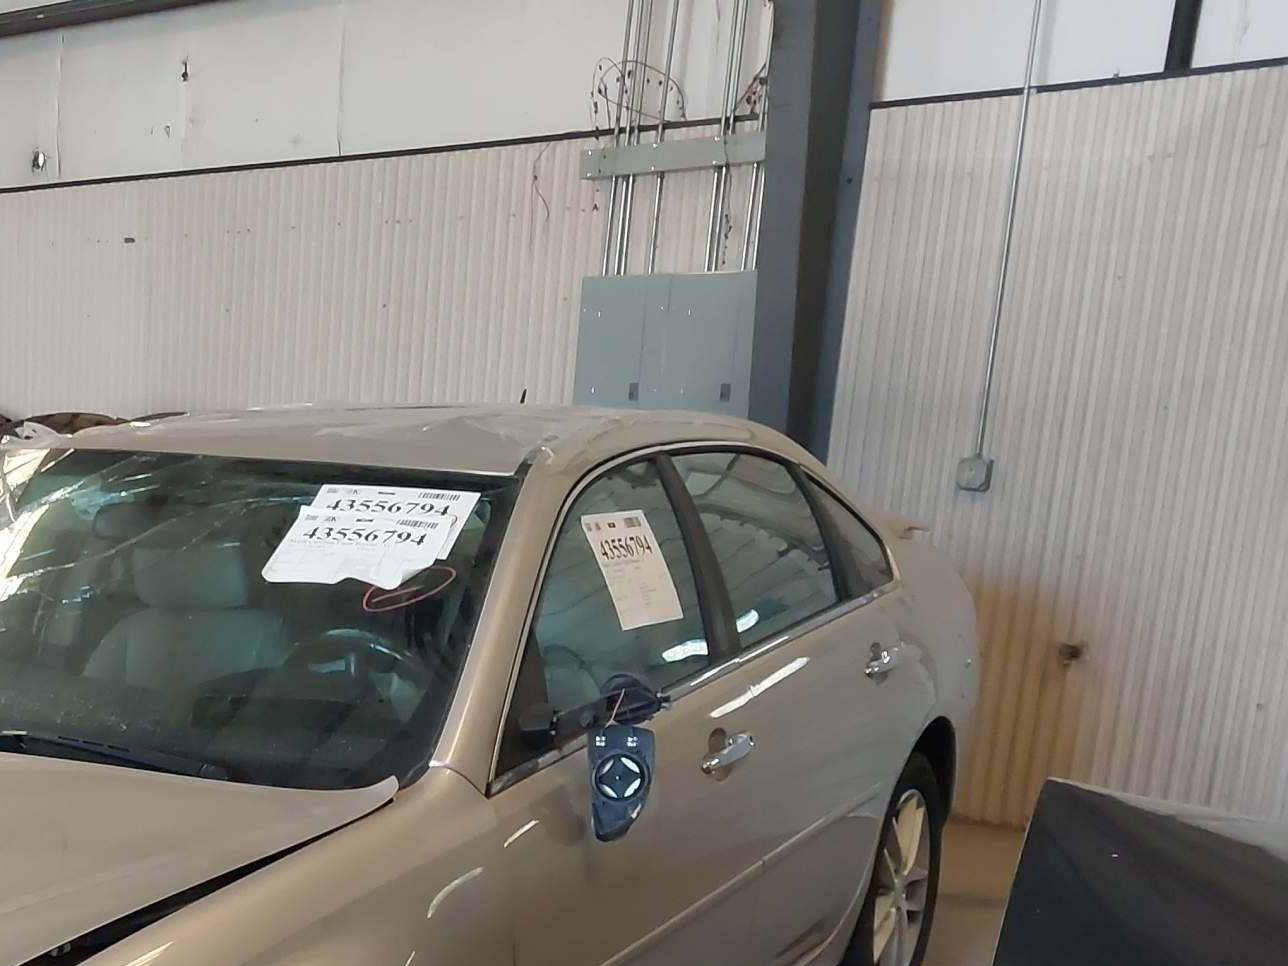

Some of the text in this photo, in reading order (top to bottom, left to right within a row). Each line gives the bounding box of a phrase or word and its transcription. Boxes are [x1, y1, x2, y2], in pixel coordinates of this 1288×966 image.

[326, 499, 450, 516] 43556794
[303, 526, 427, 546] 43556794
[600, 535, 653, 560] 43556794
